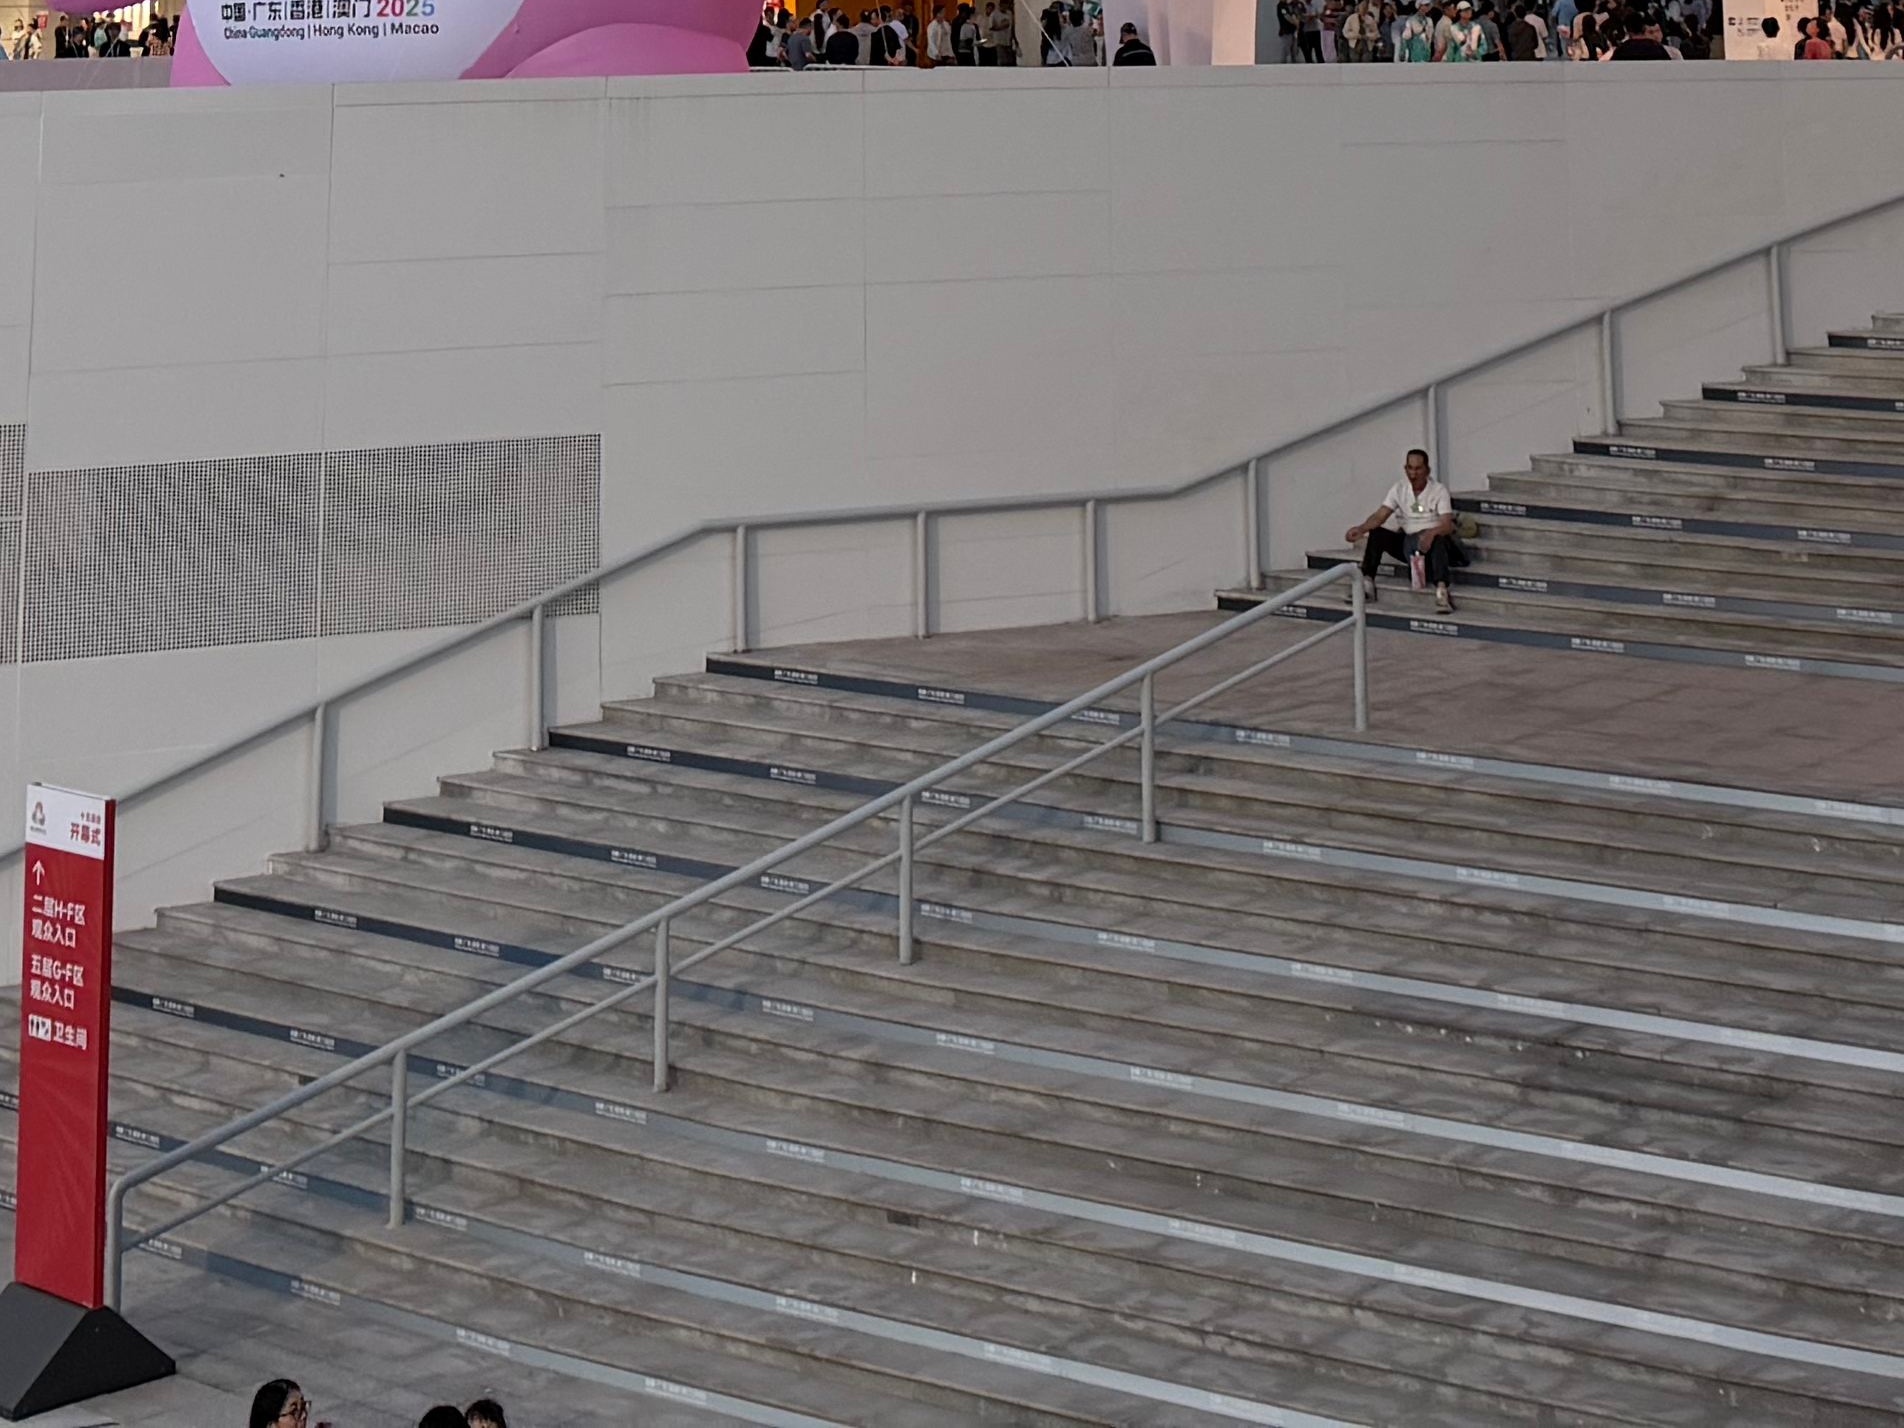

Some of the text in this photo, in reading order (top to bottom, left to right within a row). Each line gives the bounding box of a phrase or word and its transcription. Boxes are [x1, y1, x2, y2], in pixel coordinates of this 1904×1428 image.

[313, 24, 344, 40] Hong
[347, 23, 379, 38] Kong
[390, 22, 439, 35] Macao
[31, 919, 76, 948] 观众入口
[30, 979, 75, 1010] 观众入口
[53, 1020, 88, 1051] 卫生间
